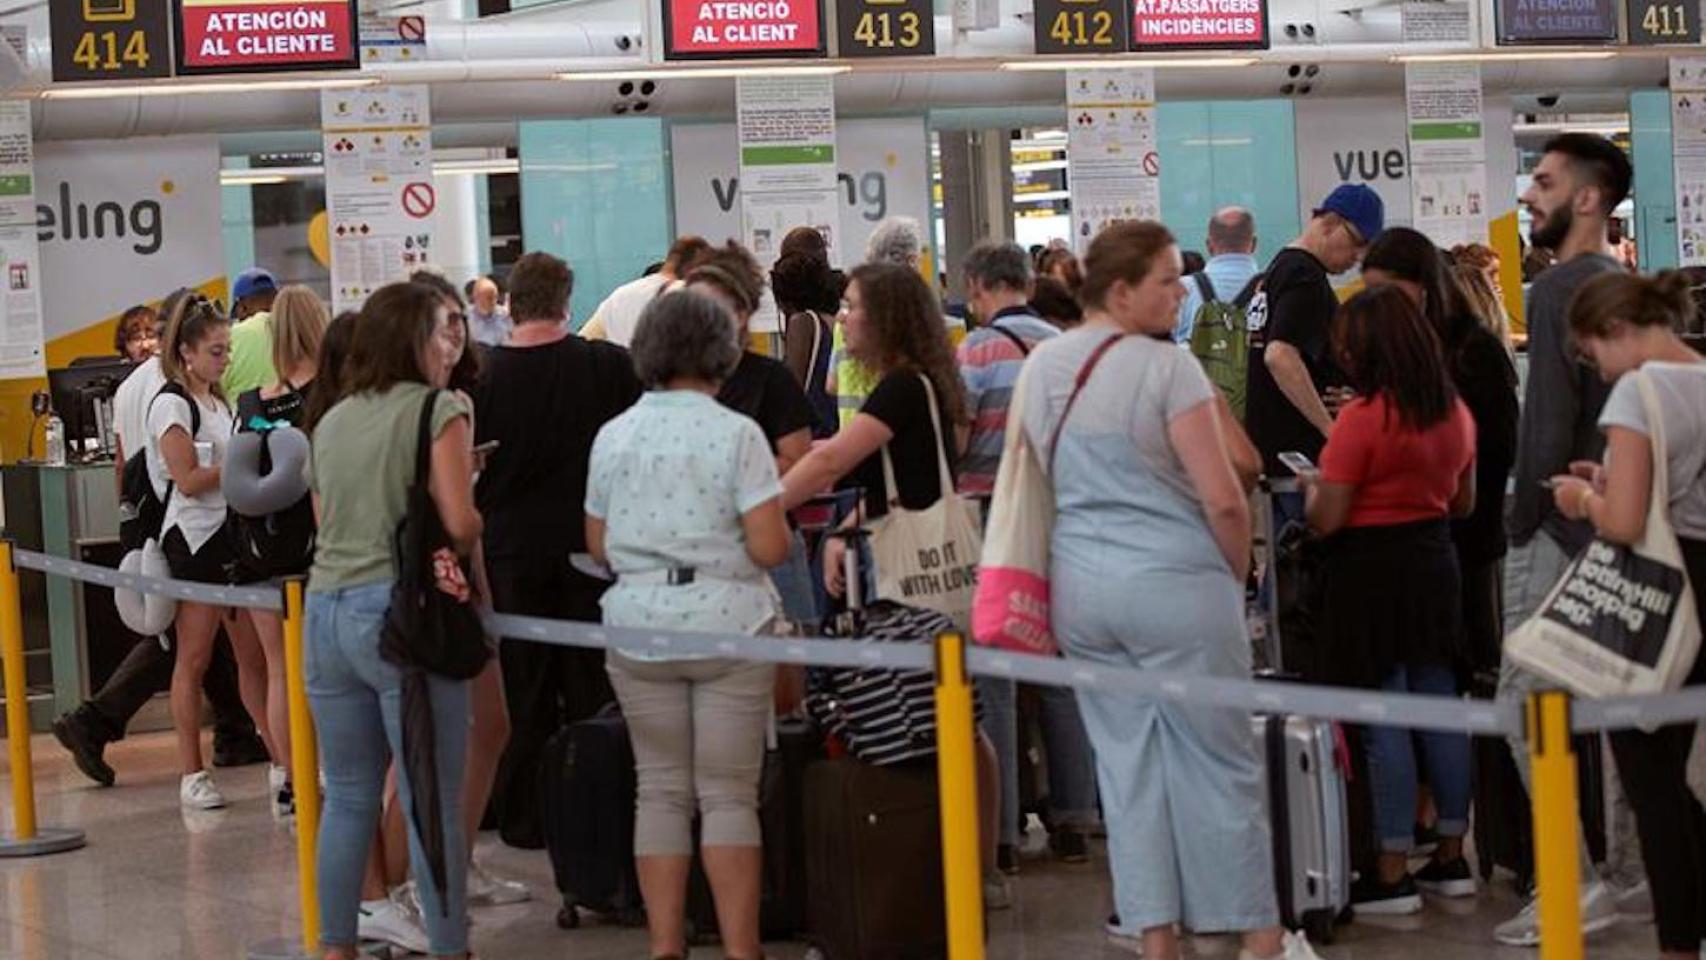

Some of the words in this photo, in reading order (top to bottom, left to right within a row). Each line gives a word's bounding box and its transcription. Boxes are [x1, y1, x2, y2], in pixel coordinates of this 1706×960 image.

[206, 8, 326, 32] ATENCIÓN
[692, 26, 719, 43] AL
[725, 24, 798, 42] CLIENT
[854, 12, 920, 48] 413
[1051, 11, 1113, 46] 412
[1142, 16, 1255, 35] INCIDÈNCIES
[1641, 5, 1688, 36] 411
[73, 30, 149, 70] 414
[200, 39, 230, 56] AL
[237, 34, 335, 54] CLIENTE
[918, 547, 940, 570] DO
[943, 540, 957, 564] IT
[899, 574, 942, 597] WITH
[943, 563, 979, 592] LOVE
